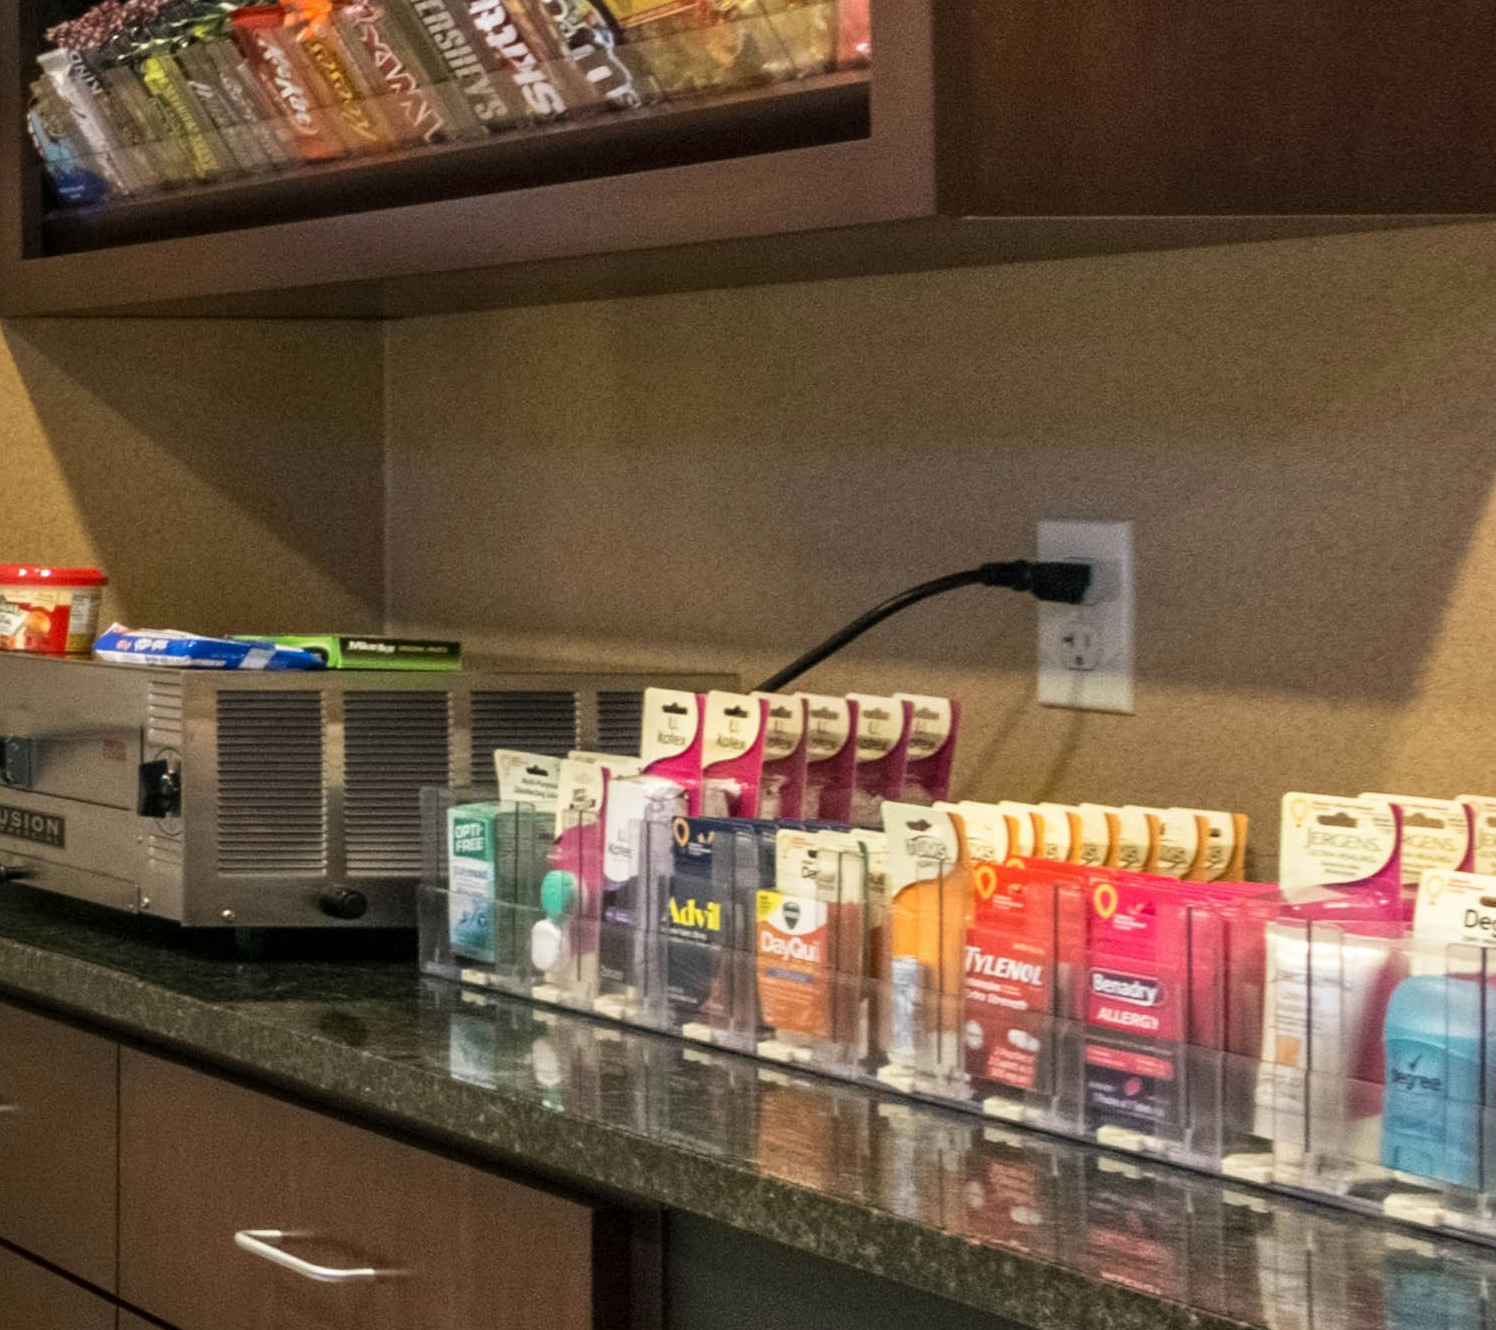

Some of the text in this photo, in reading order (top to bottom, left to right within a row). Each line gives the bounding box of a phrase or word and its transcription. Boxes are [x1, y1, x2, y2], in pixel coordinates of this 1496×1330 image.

[454, 823, 484, 839] OPTI-
[455, 837, 484, 853] FREE
[1304, 826, 1382, 852] JERGENS
[669, 896, 722, 932] Advil
[760, 930, 821, 963] DayQui
[965, 945, 1044, 986] TYLENOL
[1091, 972, 1159, 1004] Benadry
[1096, 1006, 1160, 1031] ALLERGY
